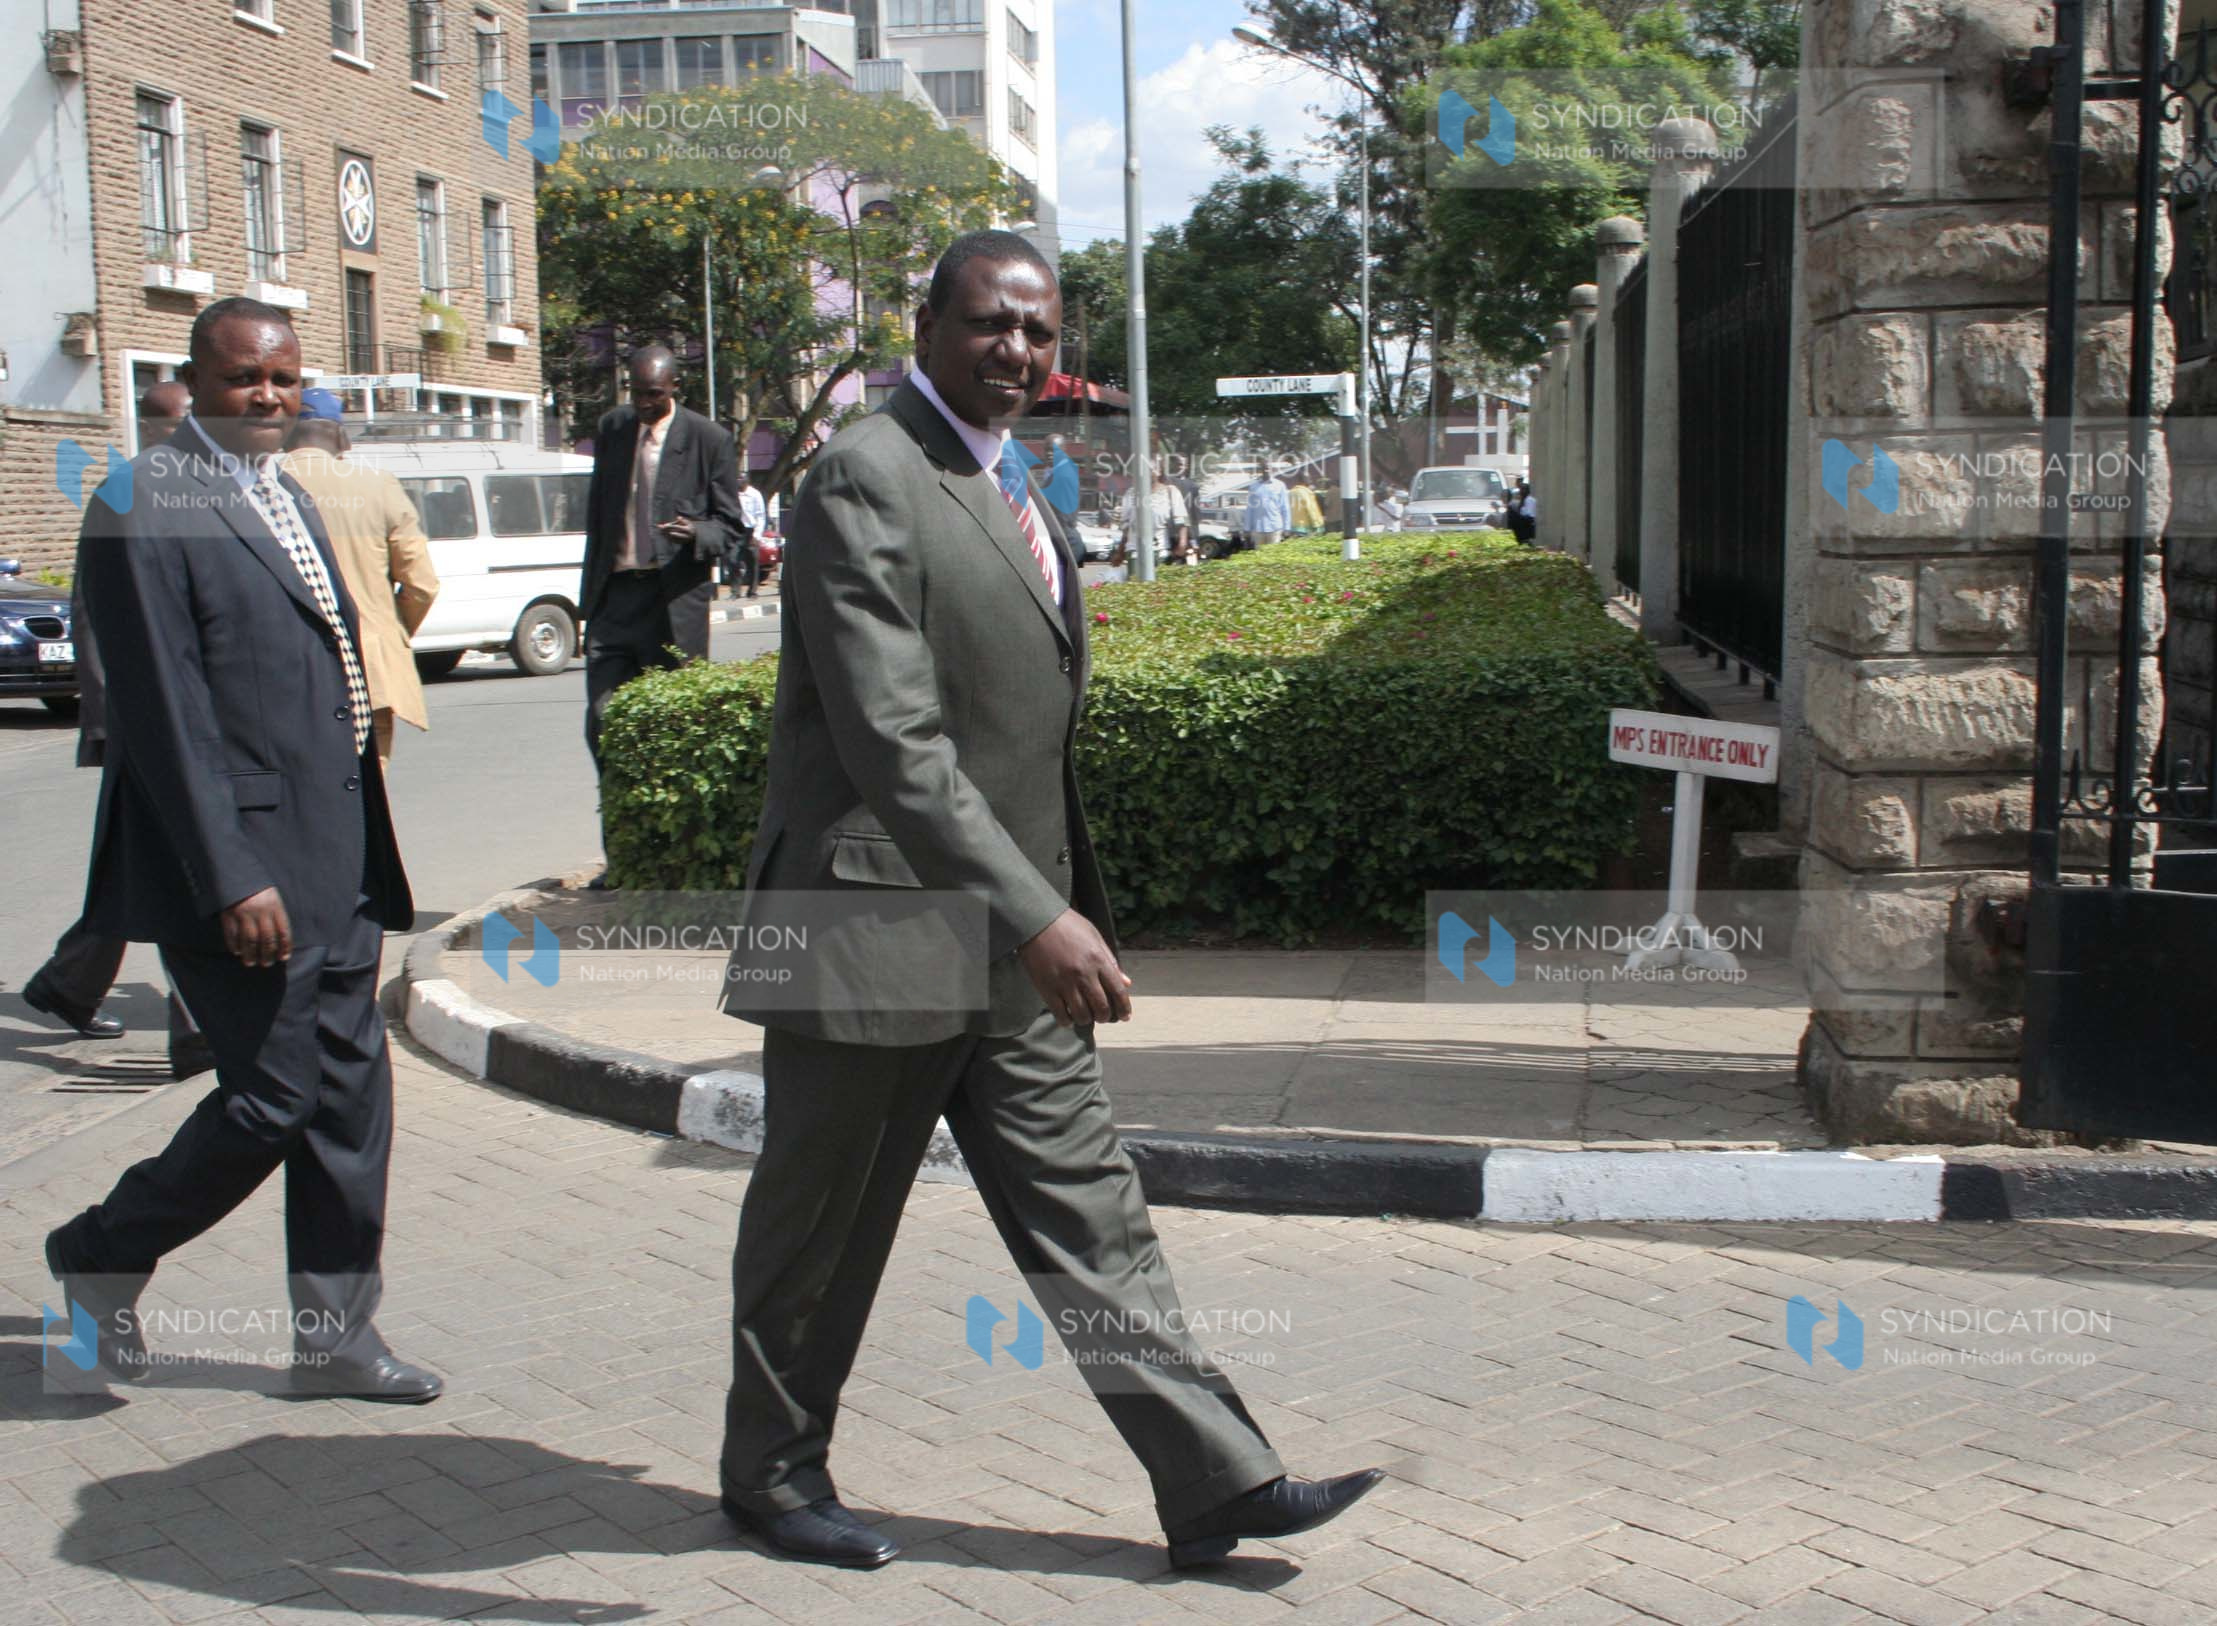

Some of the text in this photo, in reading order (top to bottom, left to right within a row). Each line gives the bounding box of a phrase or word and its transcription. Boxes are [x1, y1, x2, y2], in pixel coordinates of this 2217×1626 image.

[1246, 377, 1312, 393] COUNTY LANE
[1613, 726, 1769, 768] MPS ENTRANCE ONLY
